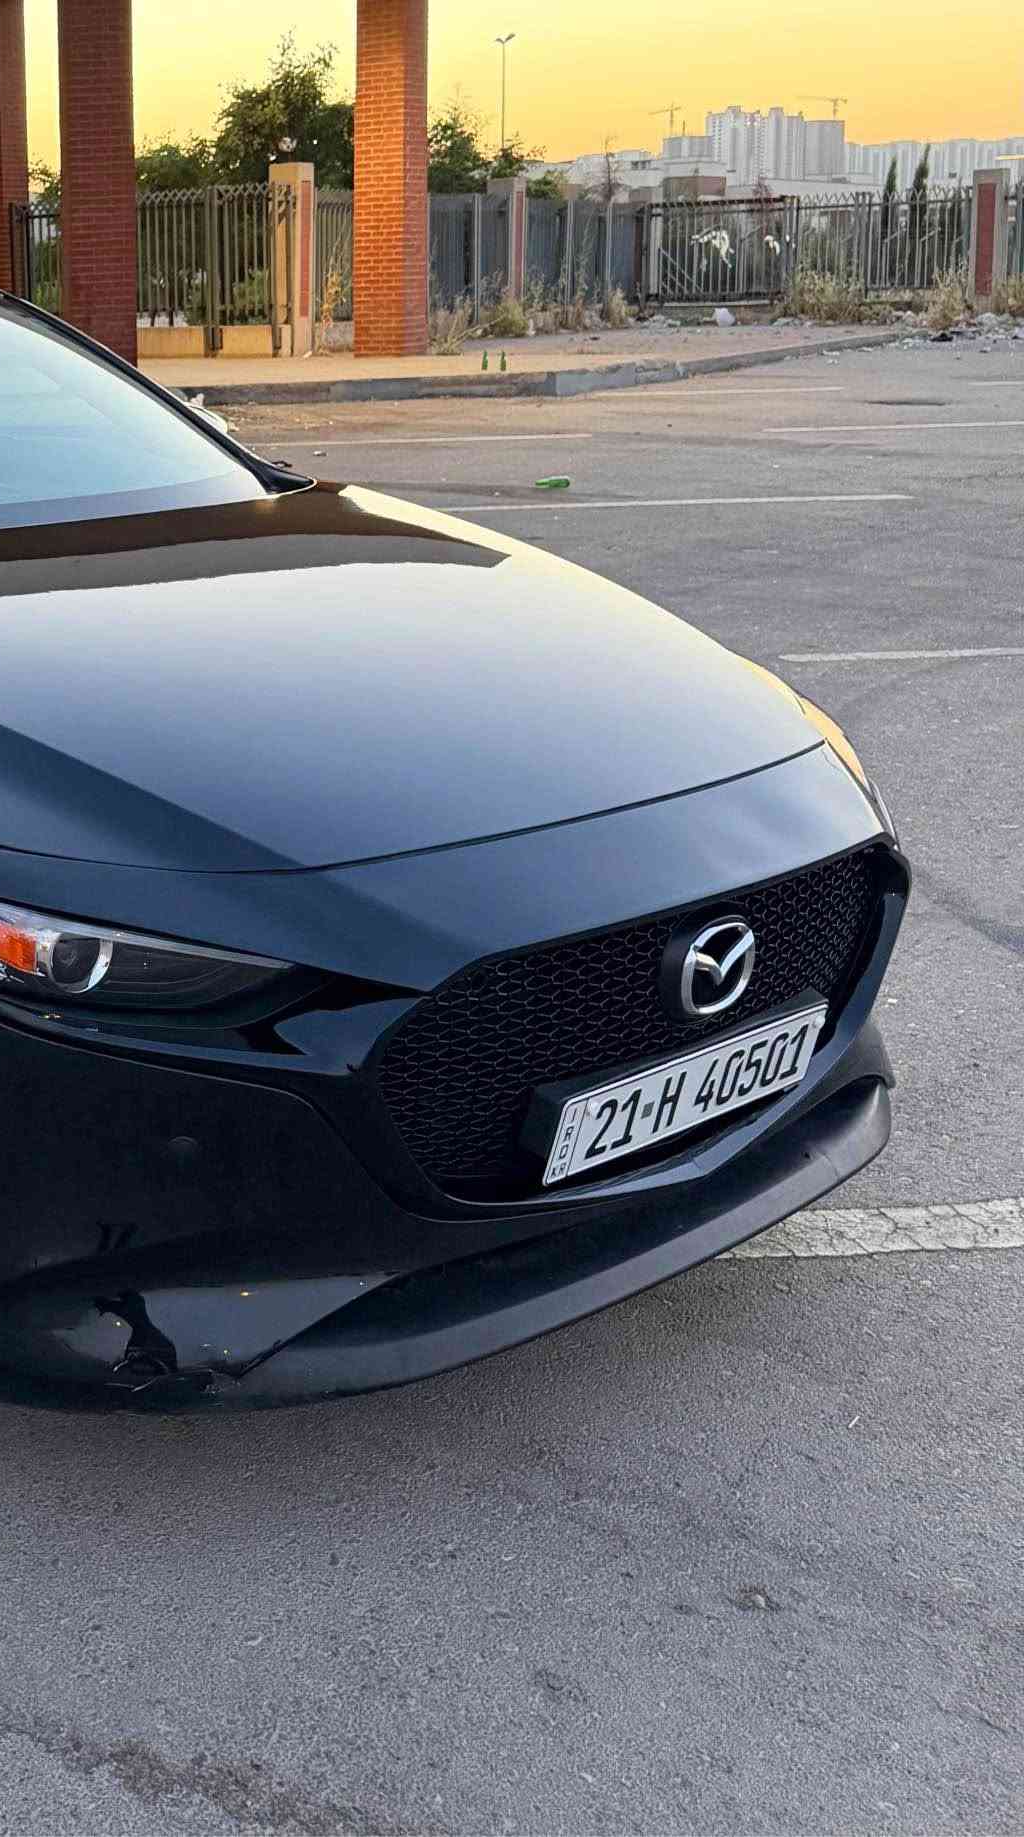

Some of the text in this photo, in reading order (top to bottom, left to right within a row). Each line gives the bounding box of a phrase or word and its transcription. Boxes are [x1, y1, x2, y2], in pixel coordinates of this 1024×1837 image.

[584, 1024, 810, 1160] 21 H 40501
